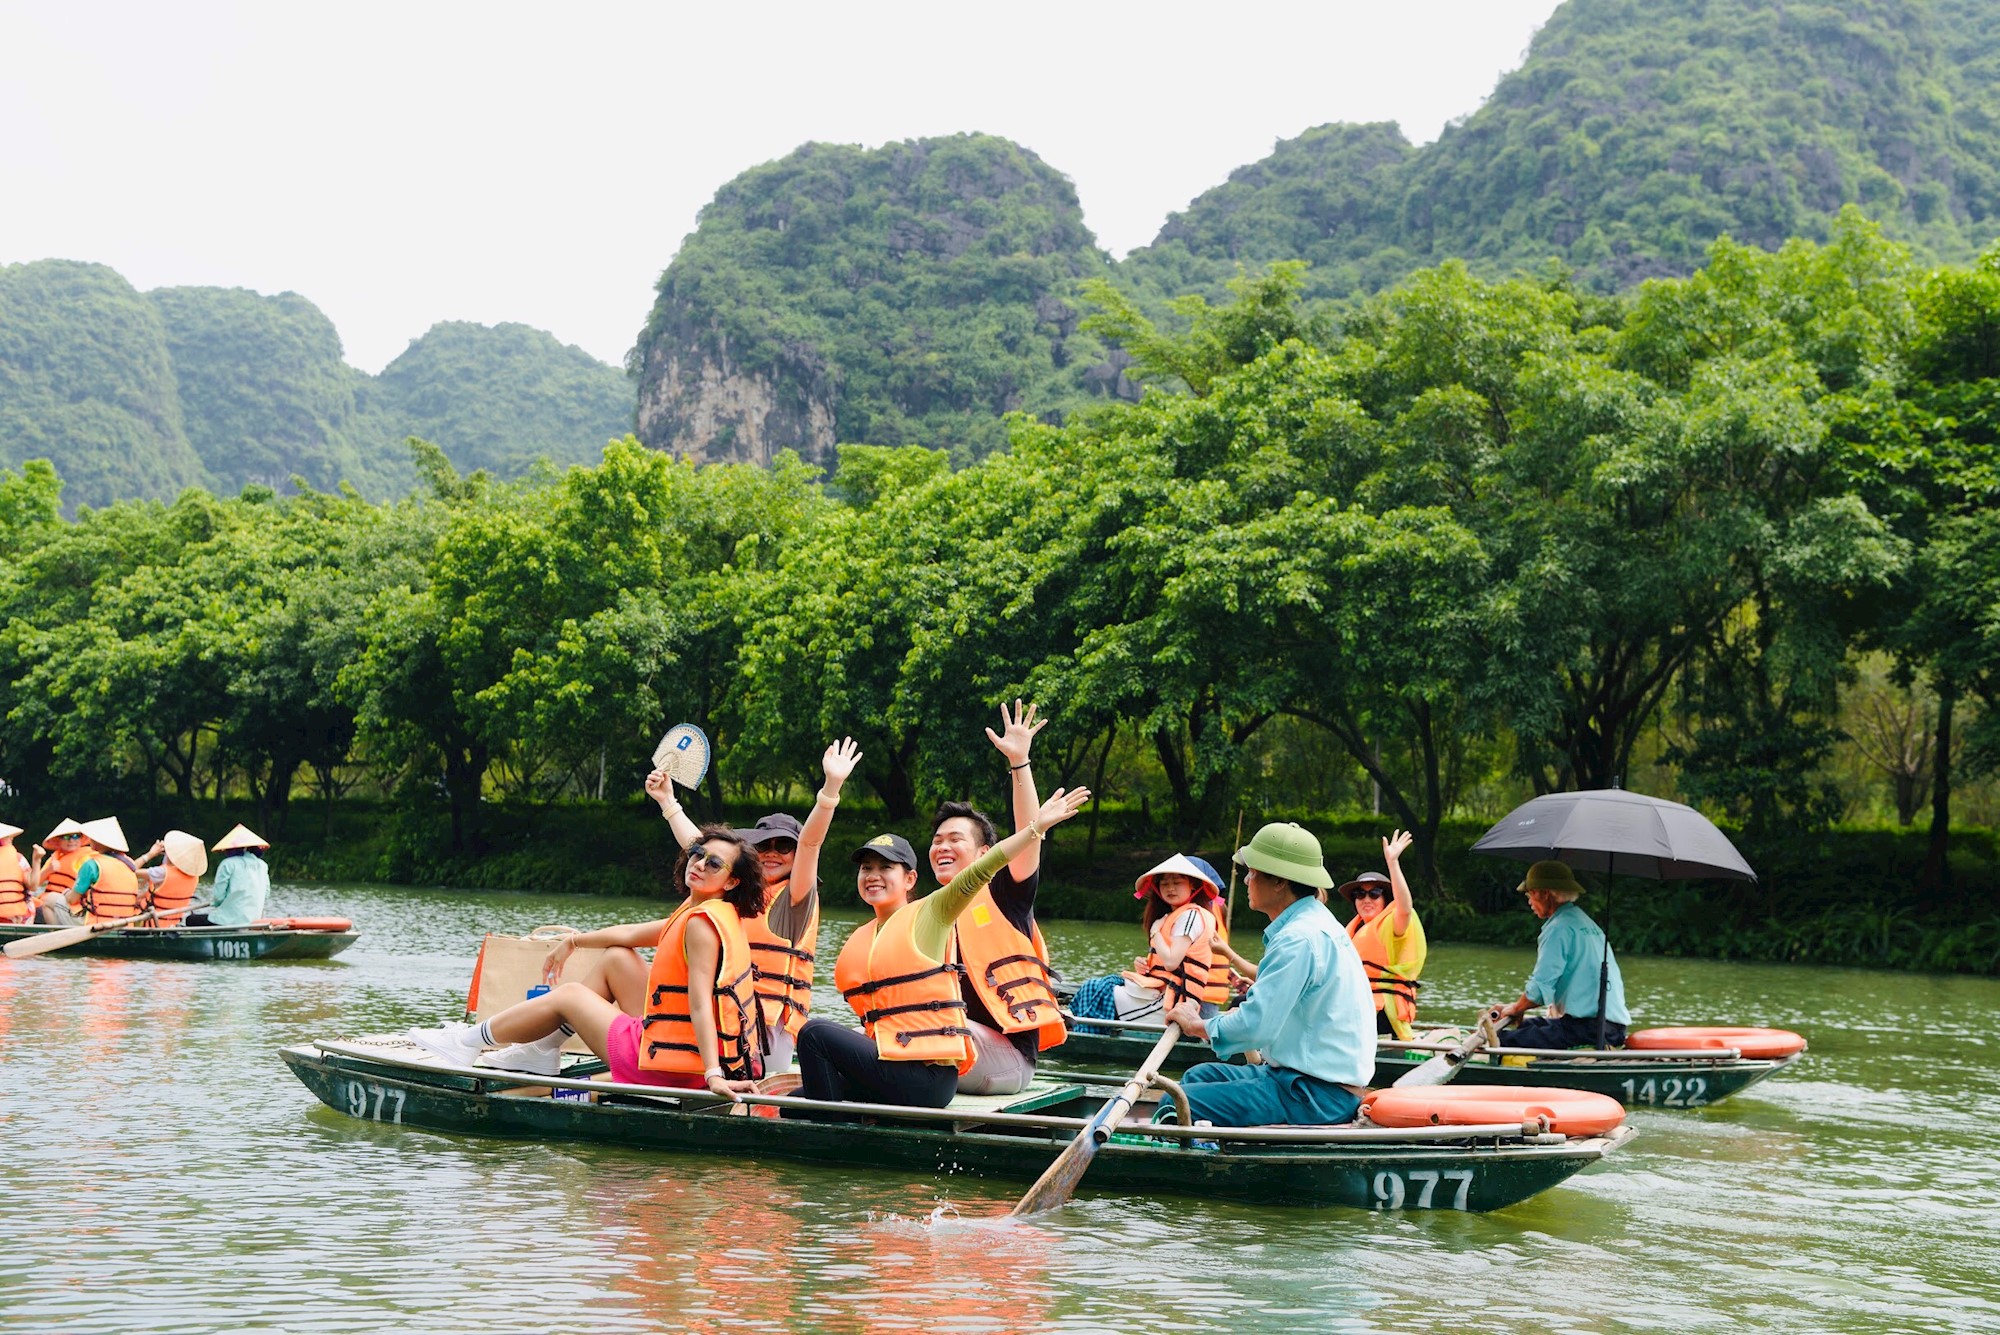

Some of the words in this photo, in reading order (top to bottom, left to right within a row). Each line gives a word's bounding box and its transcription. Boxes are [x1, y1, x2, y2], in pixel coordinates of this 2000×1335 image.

[216, 940, 250, 959] 1013
[348, 1081, 406, 1124] 977
[1621, 1078, 1707, 1106] 1422
[1373, 1169, 1474, 1211] 977
